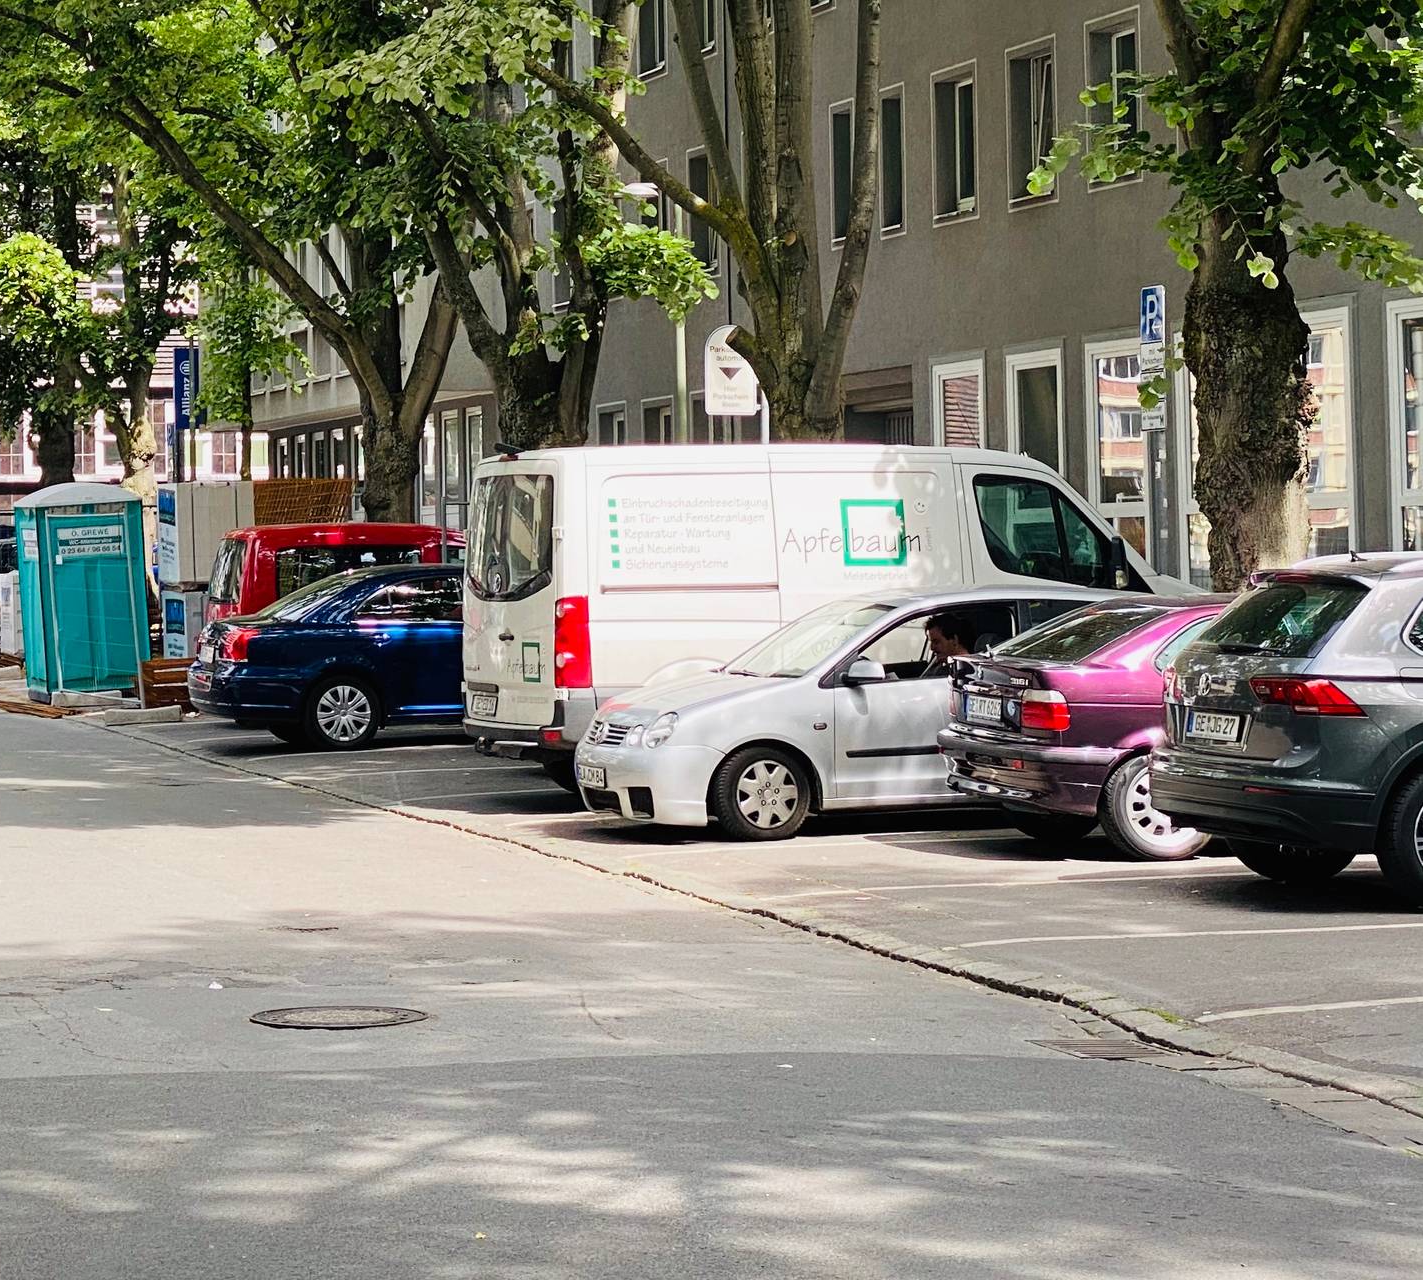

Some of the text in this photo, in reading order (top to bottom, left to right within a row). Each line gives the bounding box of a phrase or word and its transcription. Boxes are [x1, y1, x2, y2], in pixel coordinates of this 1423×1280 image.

[1146, 294, 1158, 335] P
[181, 377, 191, 417] Allianz
[621, 498, 769, 510] Einbruchschadenbeseitigung
[623, 514, 636, 523] an
[663, 512, 683, 523] und
[685, 511, 765, 525] Fensteranlagen
[81, 528, 109, 537] GREWE
[624, 527, 731, 542] Reparatur Wartung
[625, 543, 701, 554] und Neueinbau
[782, 527, 921, 564] Apfelbaum
[625, 558, 729, 572] Sicherungssysteme
[1195, 714, 1236, 735] GE JG 27
